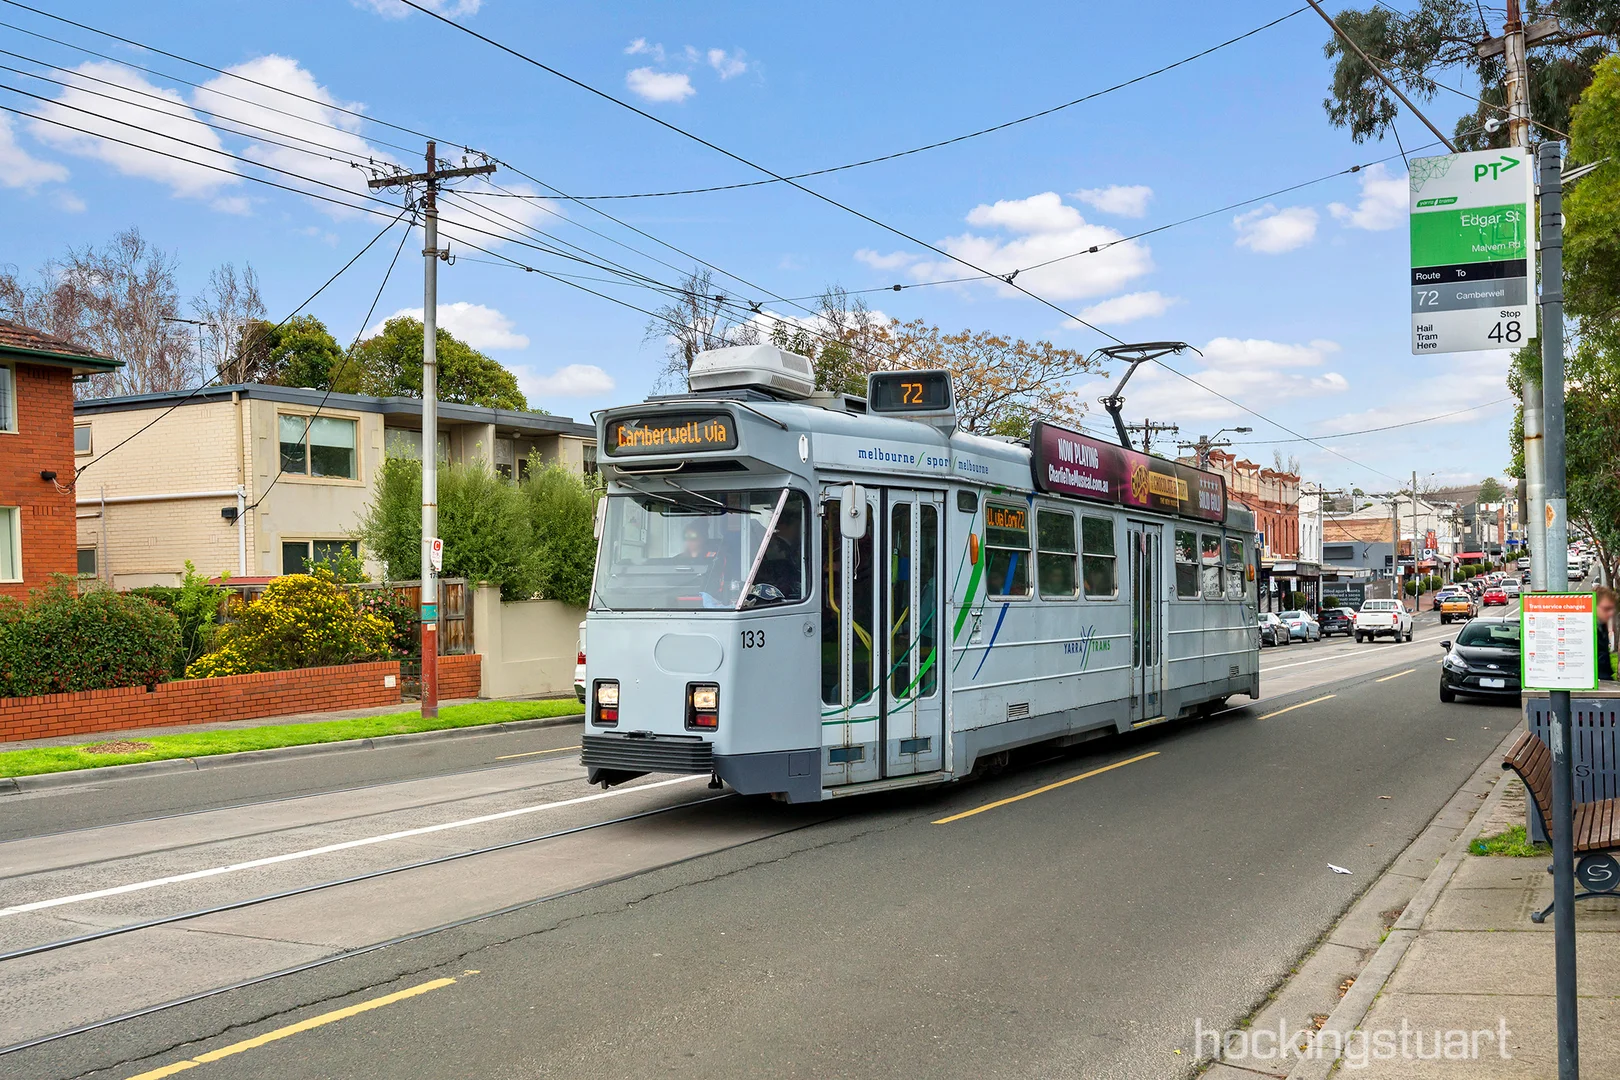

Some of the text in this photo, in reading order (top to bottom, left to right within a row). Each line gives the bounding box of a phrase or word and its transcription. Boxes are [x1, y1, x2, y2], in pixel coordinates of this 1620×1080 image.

[1461, 210, 1520, 228] Edgar St
[1471, 240, 1520, 252] Malvern Rd
[1416, 269, 1466, 281] Route To
[1417, 289, 1505, 306] 72 Camberwell
[1500, 310, 1521, 319] Stop
[1416, 324, 1433, 332] Hail
[1487, 320, 1522, 344] 48
[1416, 333, 1438, 341] Tram
[1416, 341, 1437, 350] Here
[900, 383, 923, 404] 72
[617, 420, 727, 447] Camberwell via
[857, 448, 915, 463] melbourne
[1057, 438, 1099, 470] NOW PLAYING
[958, 459, 989, 475] melbourne
[740, 630, 765, 649] 133
[1063, 640, 1111, 654] YARRA TRAMS
